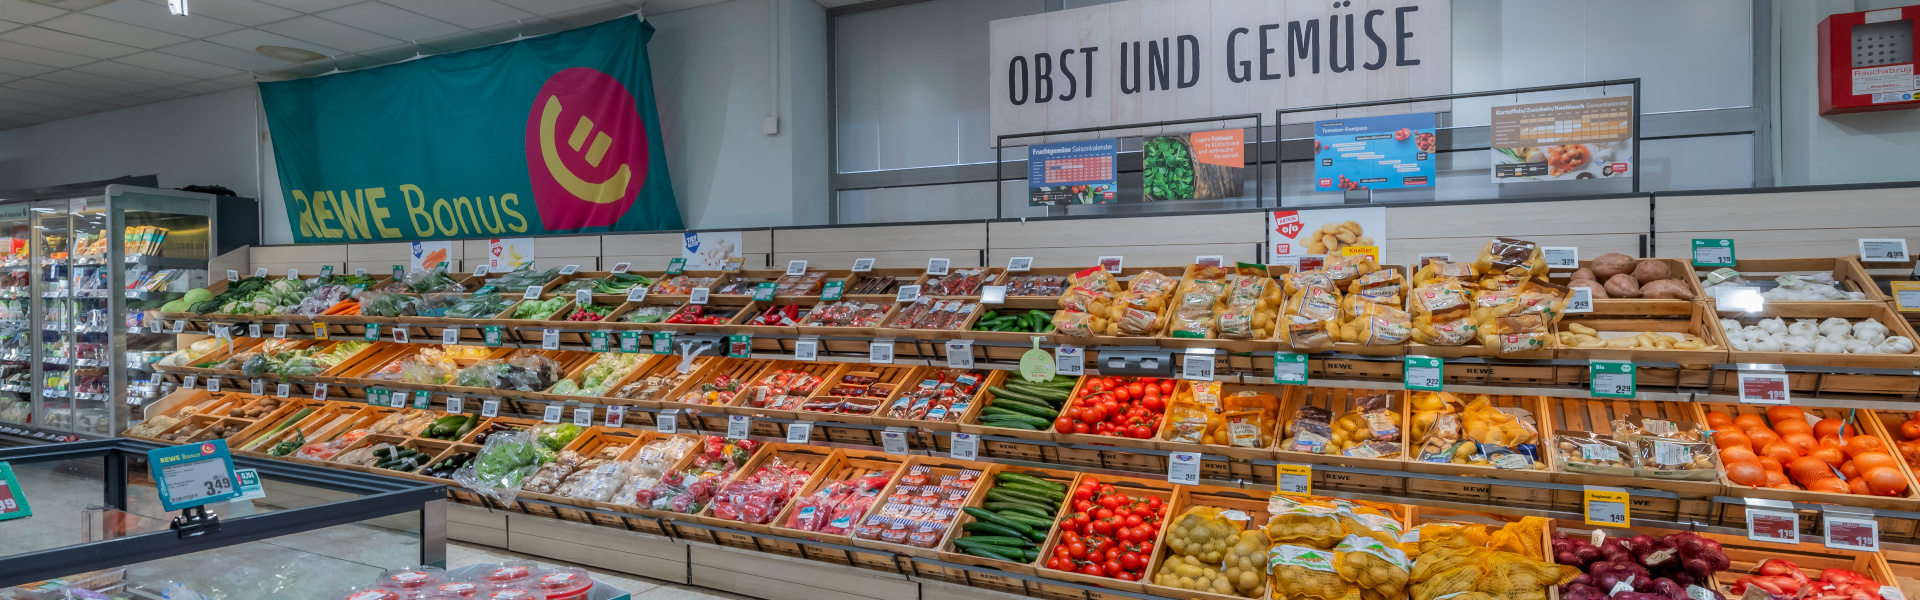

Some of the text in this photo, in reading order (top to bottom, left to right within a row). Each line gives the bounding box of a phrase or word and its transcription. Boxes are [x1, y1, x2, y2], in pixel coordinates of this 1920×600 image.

[1008, 0, 1421, 106] OBST UND GEMÜSE
[1854, 66, 1912, 76] Rauchabzug
[1585, 100, 1629, 109] Saisonkalender
[1322, 126, 1368, 134] Tomaten-Kompass
[1032, 146, 1071, 156] Fruchtgemüse
[1071, 143, 1113, 153] Saisonkalender
[292, 183, 528, 240] REWE Bonus
[1279, 215, 1297, 224] AKTION
[159, 454, 181, 464] REWE
